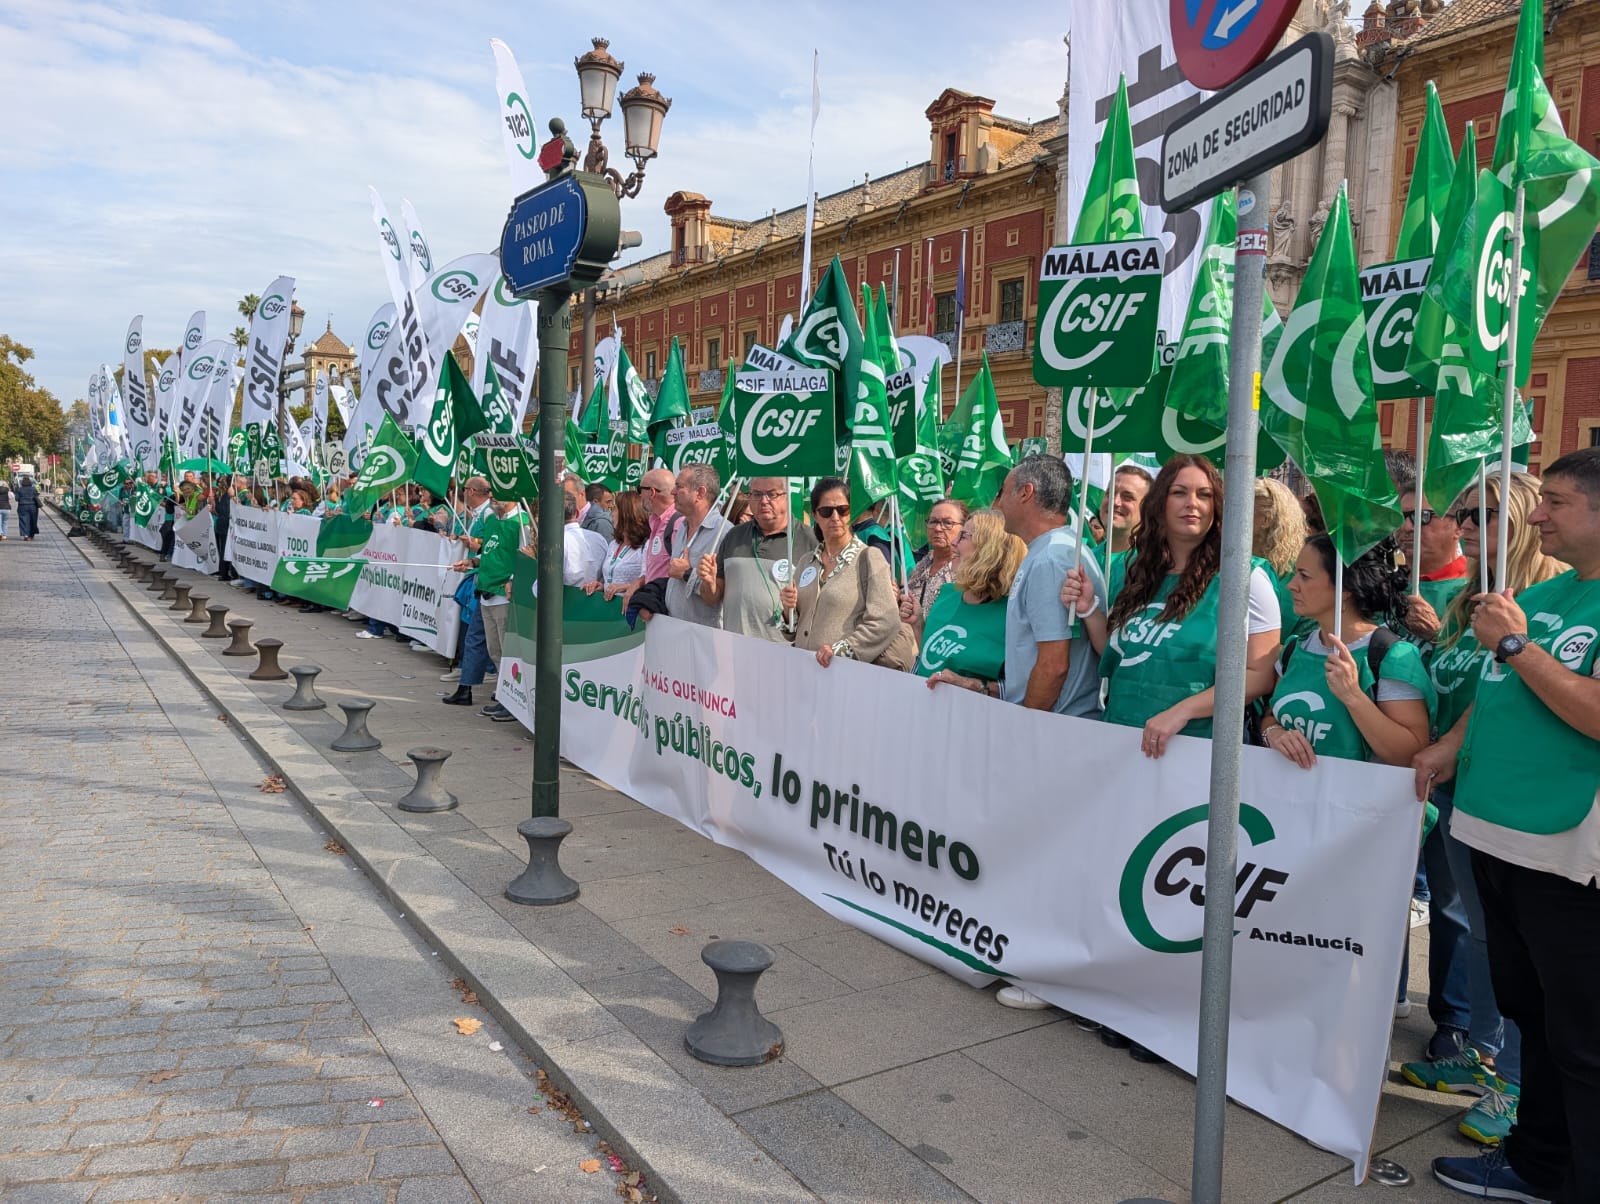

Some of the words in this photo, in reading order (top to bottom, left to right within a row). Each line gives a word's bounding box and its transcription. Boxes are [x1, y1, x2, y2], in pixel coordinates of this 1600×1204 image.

[1167, 145, 1199, 180] ZONA
[1202, 128, 1220, 160] DE
[1225, 78, 1306, 147] SEGURIDAD
[514, 209, 547, 242] PASEO
[548, 202, 566, 227] DE
[523, 238, 554, 266] ROMA
[1044, 247, 1160, 276] MÁLAGA
[443, 277, 477, 300] CSIF
[265, 302, 287, 314] CSIF
[1060, 292, 1147, 333] CSIF
[215, 367, 229, 377] SIF
[248, 336, 278, 411] CSIF
[773, 373, 828, 392] MÁLAGA
[128, 370, 149, 427] CSIF
[666, 431, 685, 444] CSIF
[756, 408, 822, 438] CSIF
[493, 455, 520, 474] CSIF
[287, 537, 309, 553] TODO
[1120, 615, 1182, 648] CSIF
[930, 636, 965, 659] CSIF
[651, 671, 669, 694] MÁS
[672, 680, 697, 702] QUE
[698, 687, 737, 719] NUNCA
[655, 711, 763, 800] públicos,
[771, 752, 802, 805] lo
[810, 780, 981, 882] primero
[823, 842, 857, 882] Tú
[860, 858, 887, 897] lo
[893, 879, 1010, 964] mereces
[1249, 927, 1365, 957] Andalucía
